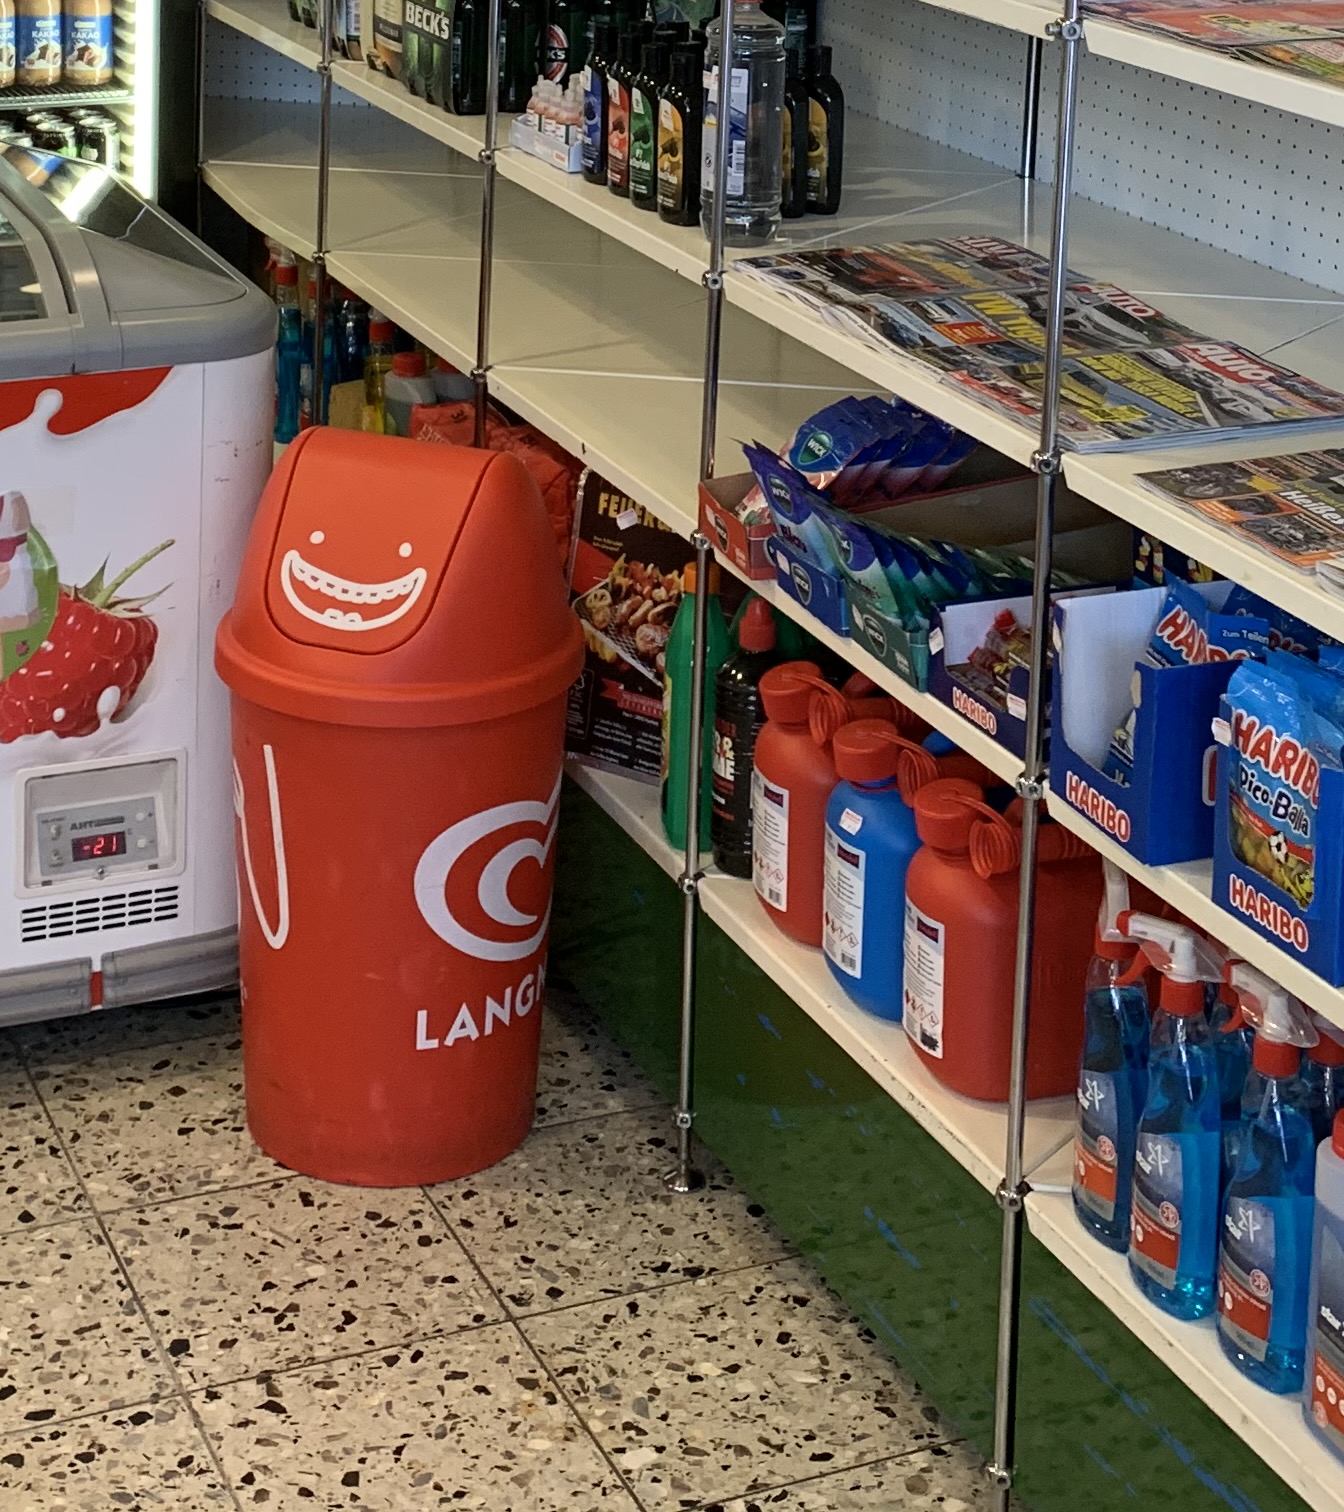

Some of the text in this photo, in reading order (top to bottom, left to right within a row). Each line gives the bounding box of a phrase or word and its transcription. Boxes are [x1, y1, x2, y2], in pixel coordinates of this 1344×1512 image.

[406, 0, 450, 40] BECK'S
[32, 30, 59, 39] KAKAO
[71, 31, 99, 39] KAKAO
[807, 438, 828, 458] WICK
[1222, 630, 1270, 645] Zum Teilen
[952, 687, 998, 737] HARIBO
[1065, 771, 1132, 843] HARIBO
[1237, 768, 1311, 840] Pico-Balla
[82, 835, 118, 856] -21
[1228, 873, 1310, 954] HARIBO
[1320, 1305, 1342, 1332] star
